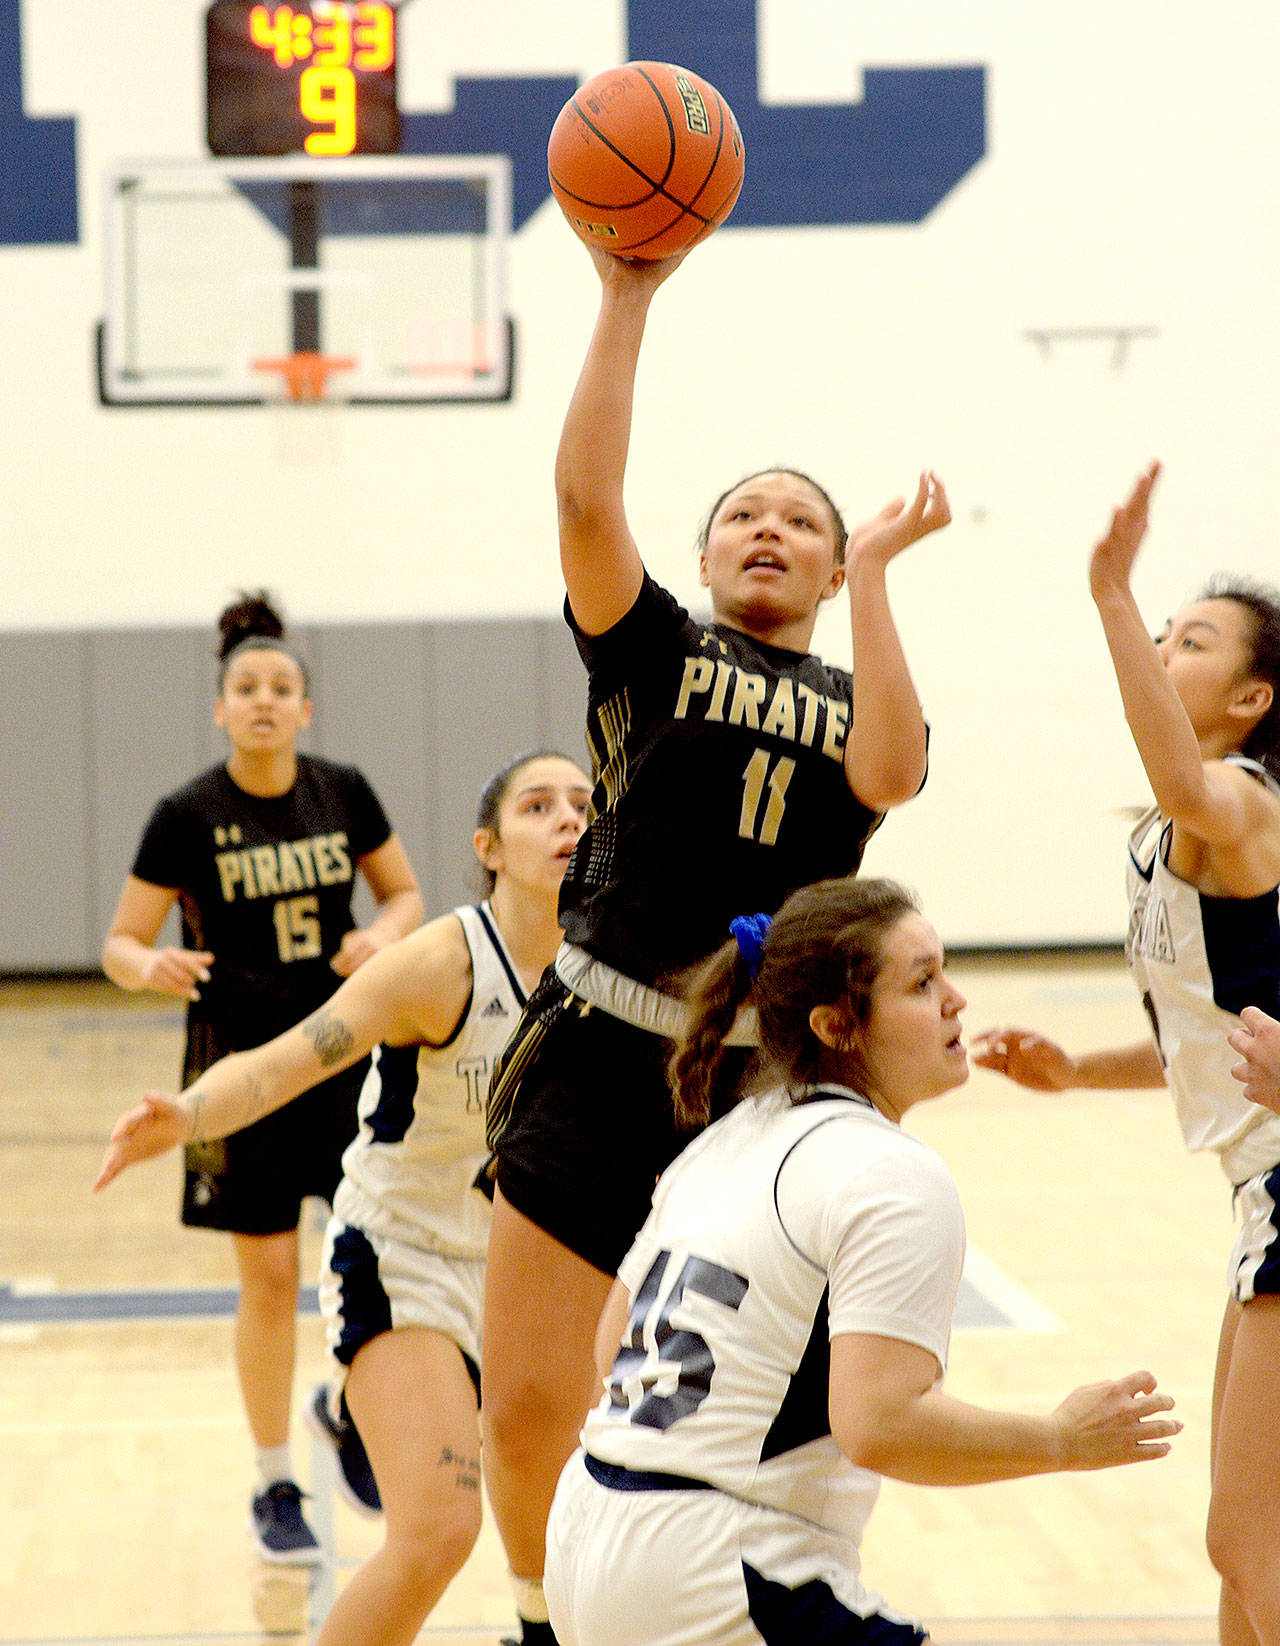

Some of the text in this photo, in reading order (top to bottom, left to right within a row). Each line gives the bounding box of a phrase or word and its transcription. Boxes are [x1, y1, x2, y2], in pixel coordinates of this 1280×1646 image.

[249, 1, 395, 71] 4:33
[299, 64, 357, 158] 9
[673, 656, 849, 765] PIRATE
[738, 747, 796, 846] 11
[215, 831, 352, 903] PIRATES
[273, 894, 322, 963] 15
